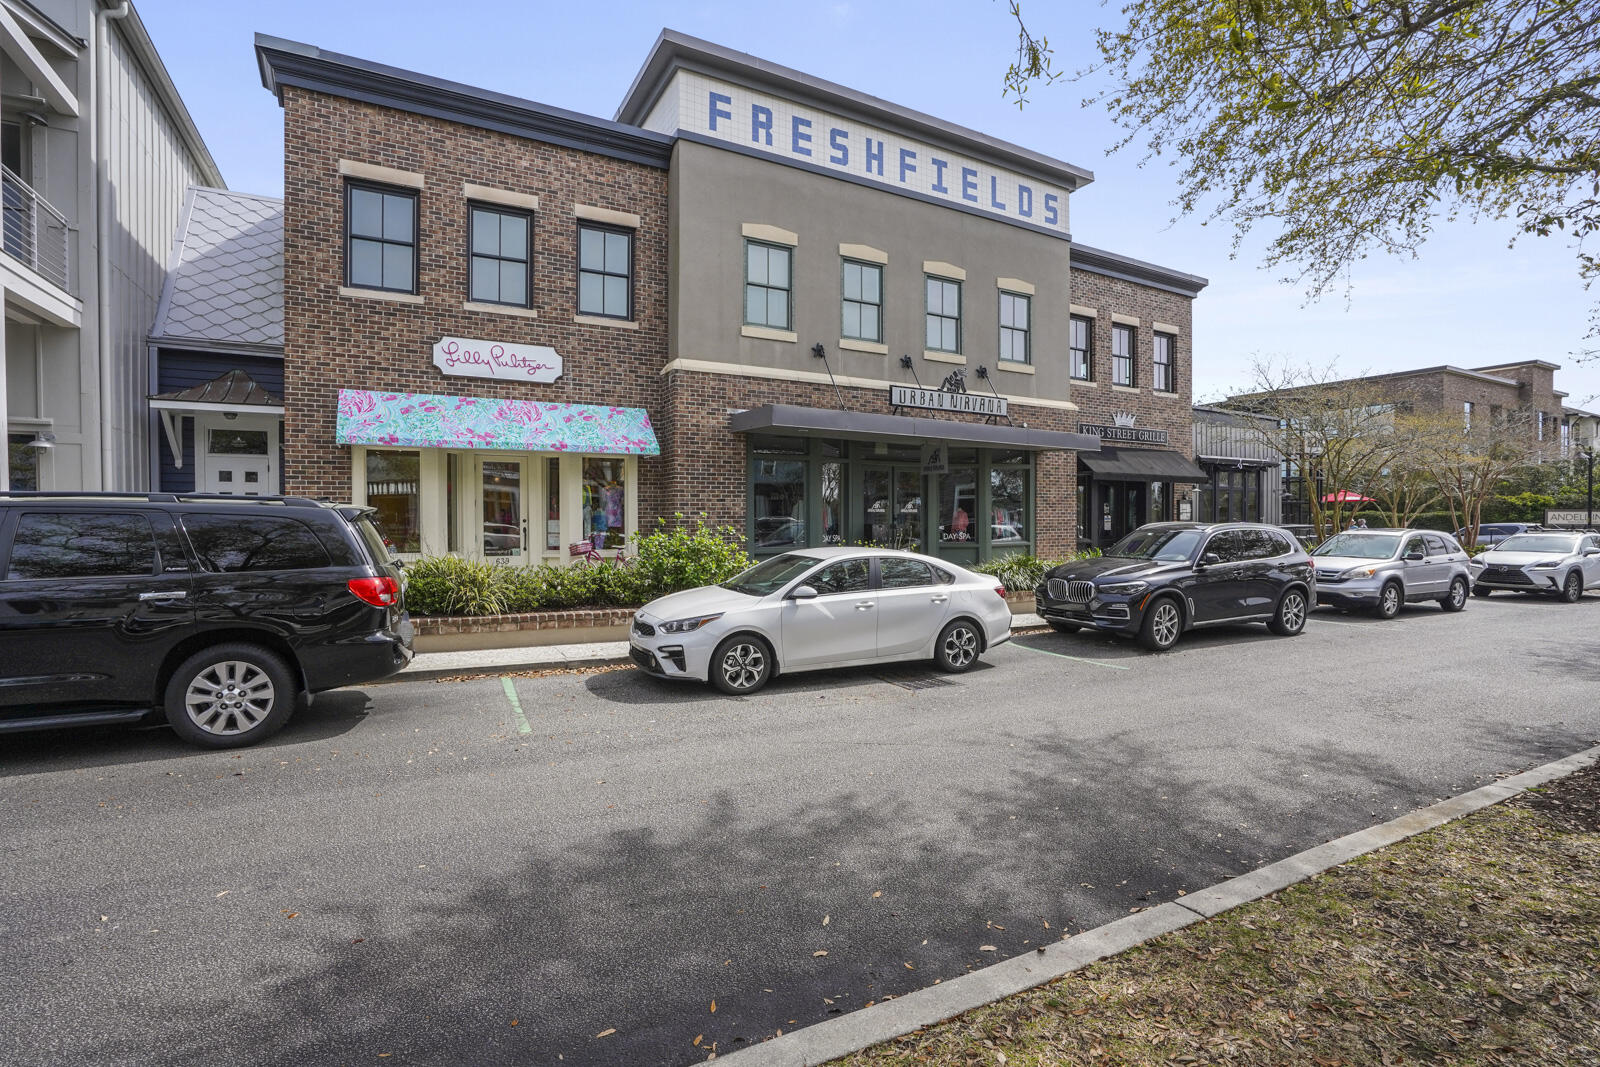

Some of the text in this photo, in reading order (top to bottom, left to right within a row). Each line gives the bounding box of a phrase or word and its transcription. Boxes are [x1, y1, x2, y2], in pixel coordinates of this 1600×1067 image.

[708, 91, 1059, 225] FRESHFIELDS
[441, 341, 555, 375] Lilly Pulitzer
[899, 389, 1002, 413] URBAN NIRVANA
[1081, 425, 1166, 442] KING STREET GRILLE
[958, 532, 971, 540] SPA
